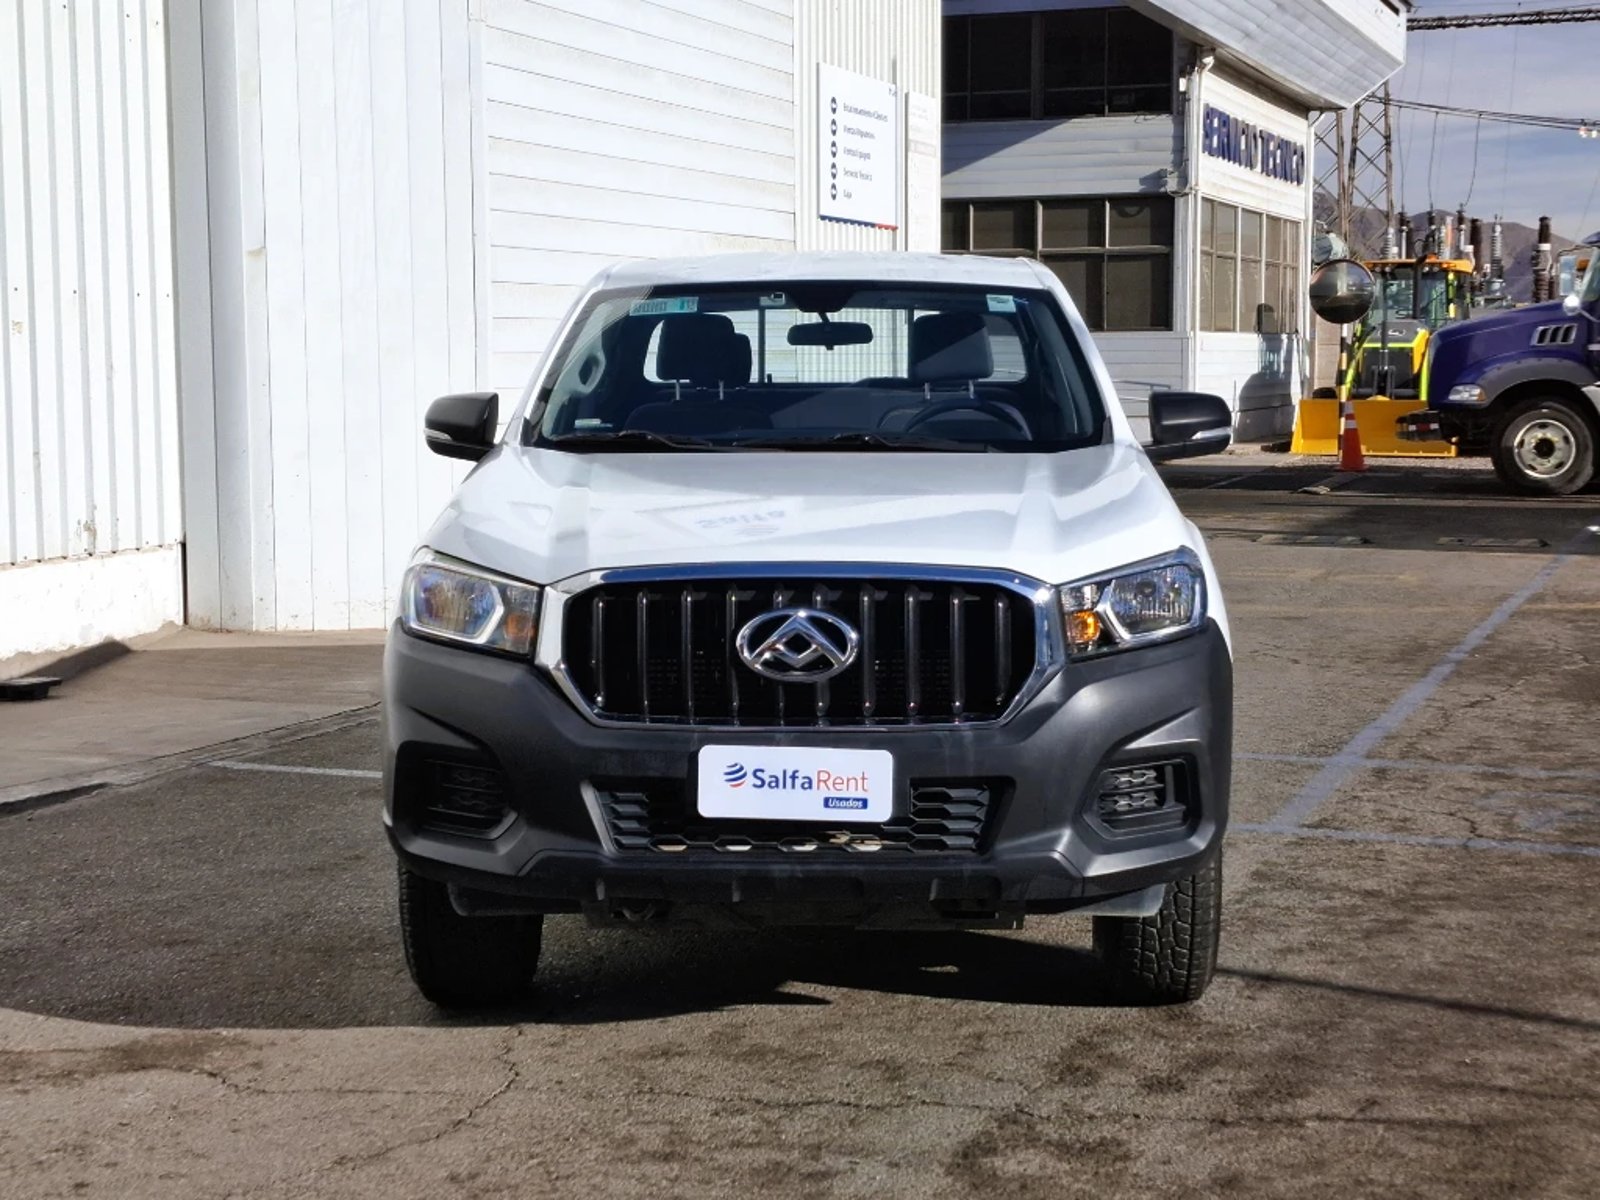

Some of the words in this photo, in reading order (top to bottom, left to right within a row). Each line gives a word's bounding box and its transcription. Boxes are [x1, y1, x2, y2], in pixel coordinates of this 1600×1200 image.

[1202, 103, 1258, 171] SERVICIO
[752, 768, 868, 792] SalfaRent
[828, 798, 863, 809] Usados
